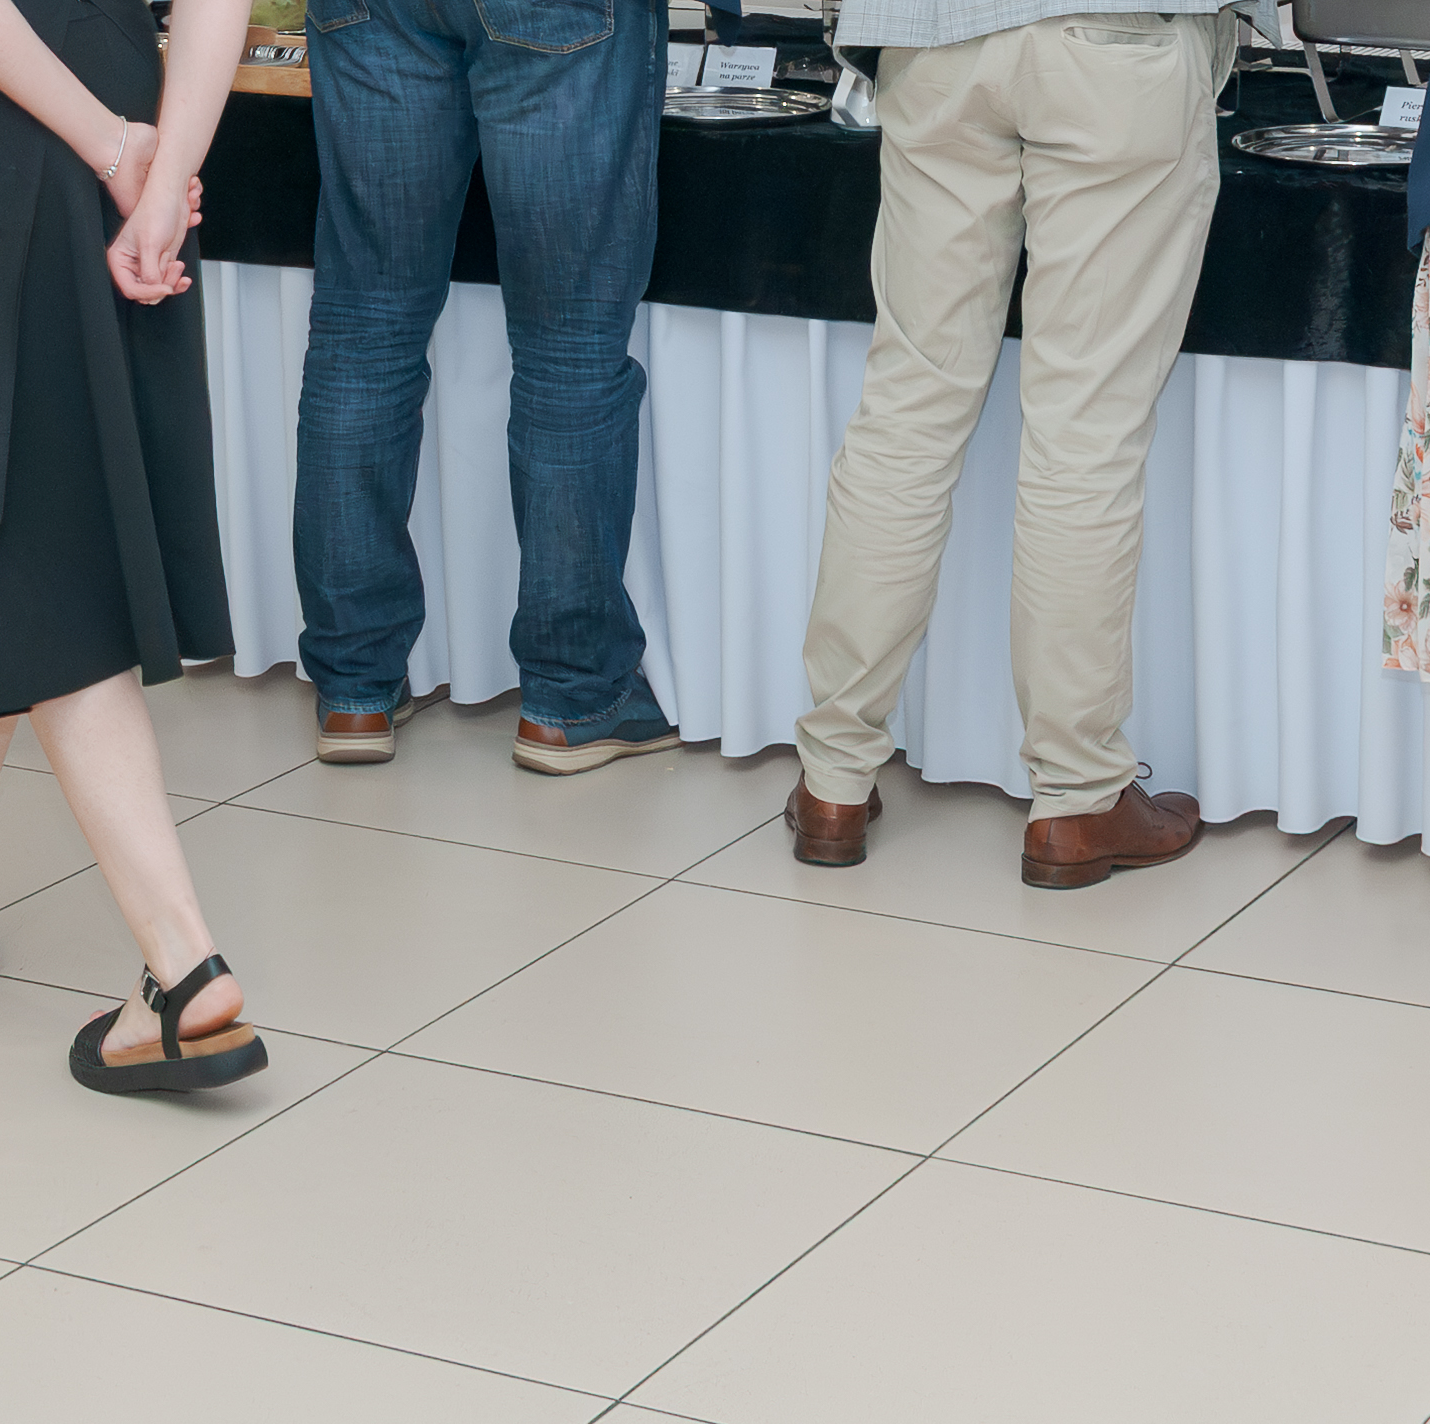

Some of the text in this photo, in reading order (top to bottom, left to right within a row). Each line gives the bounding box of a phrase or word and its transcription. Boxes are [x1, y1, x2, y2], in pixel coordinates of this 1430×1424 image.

[720, 61, 760, 72] Warzywa
[719, 72, 756, 82] na parze
